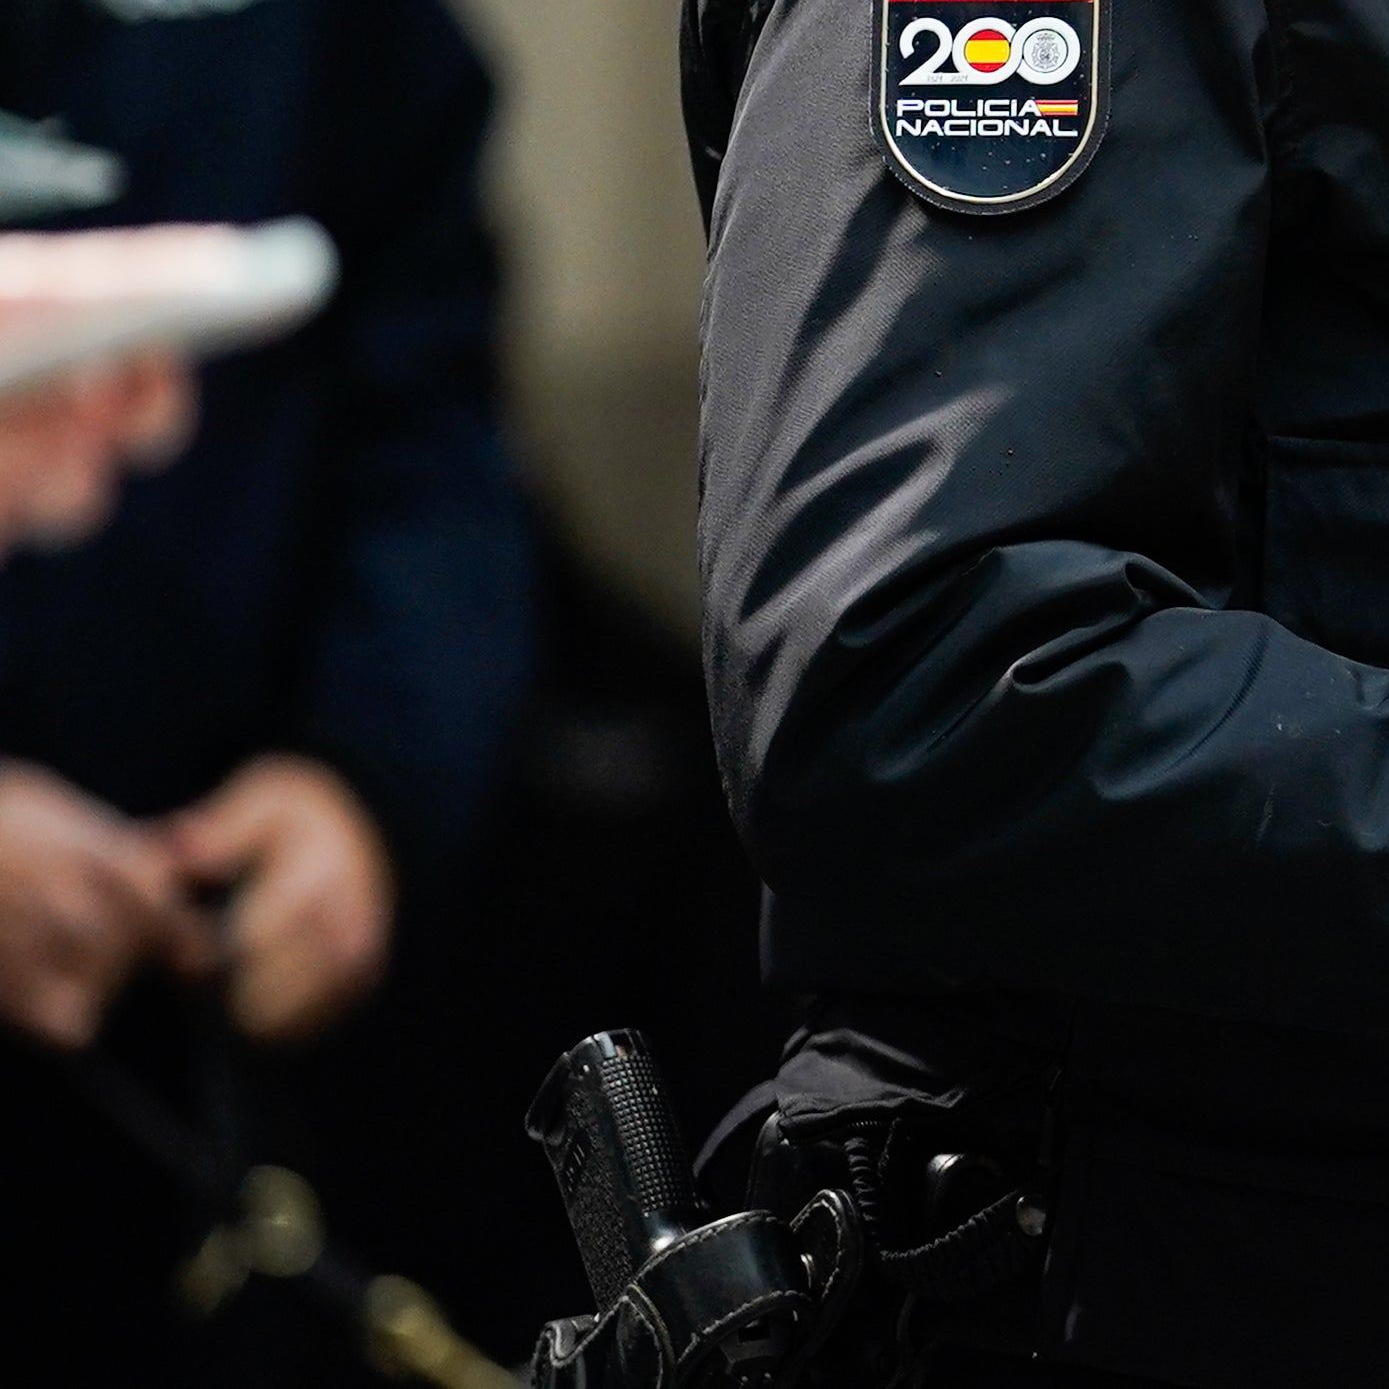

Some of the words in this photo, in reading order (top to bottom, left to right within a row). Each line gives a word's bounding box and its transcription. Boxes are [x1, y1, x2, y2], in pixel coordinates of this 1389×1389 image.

[899, 17, 1081, 85] 200
[896, 99, 1042, 117] POLICIA
[896, 119, 1079, 137] NACIONAL
